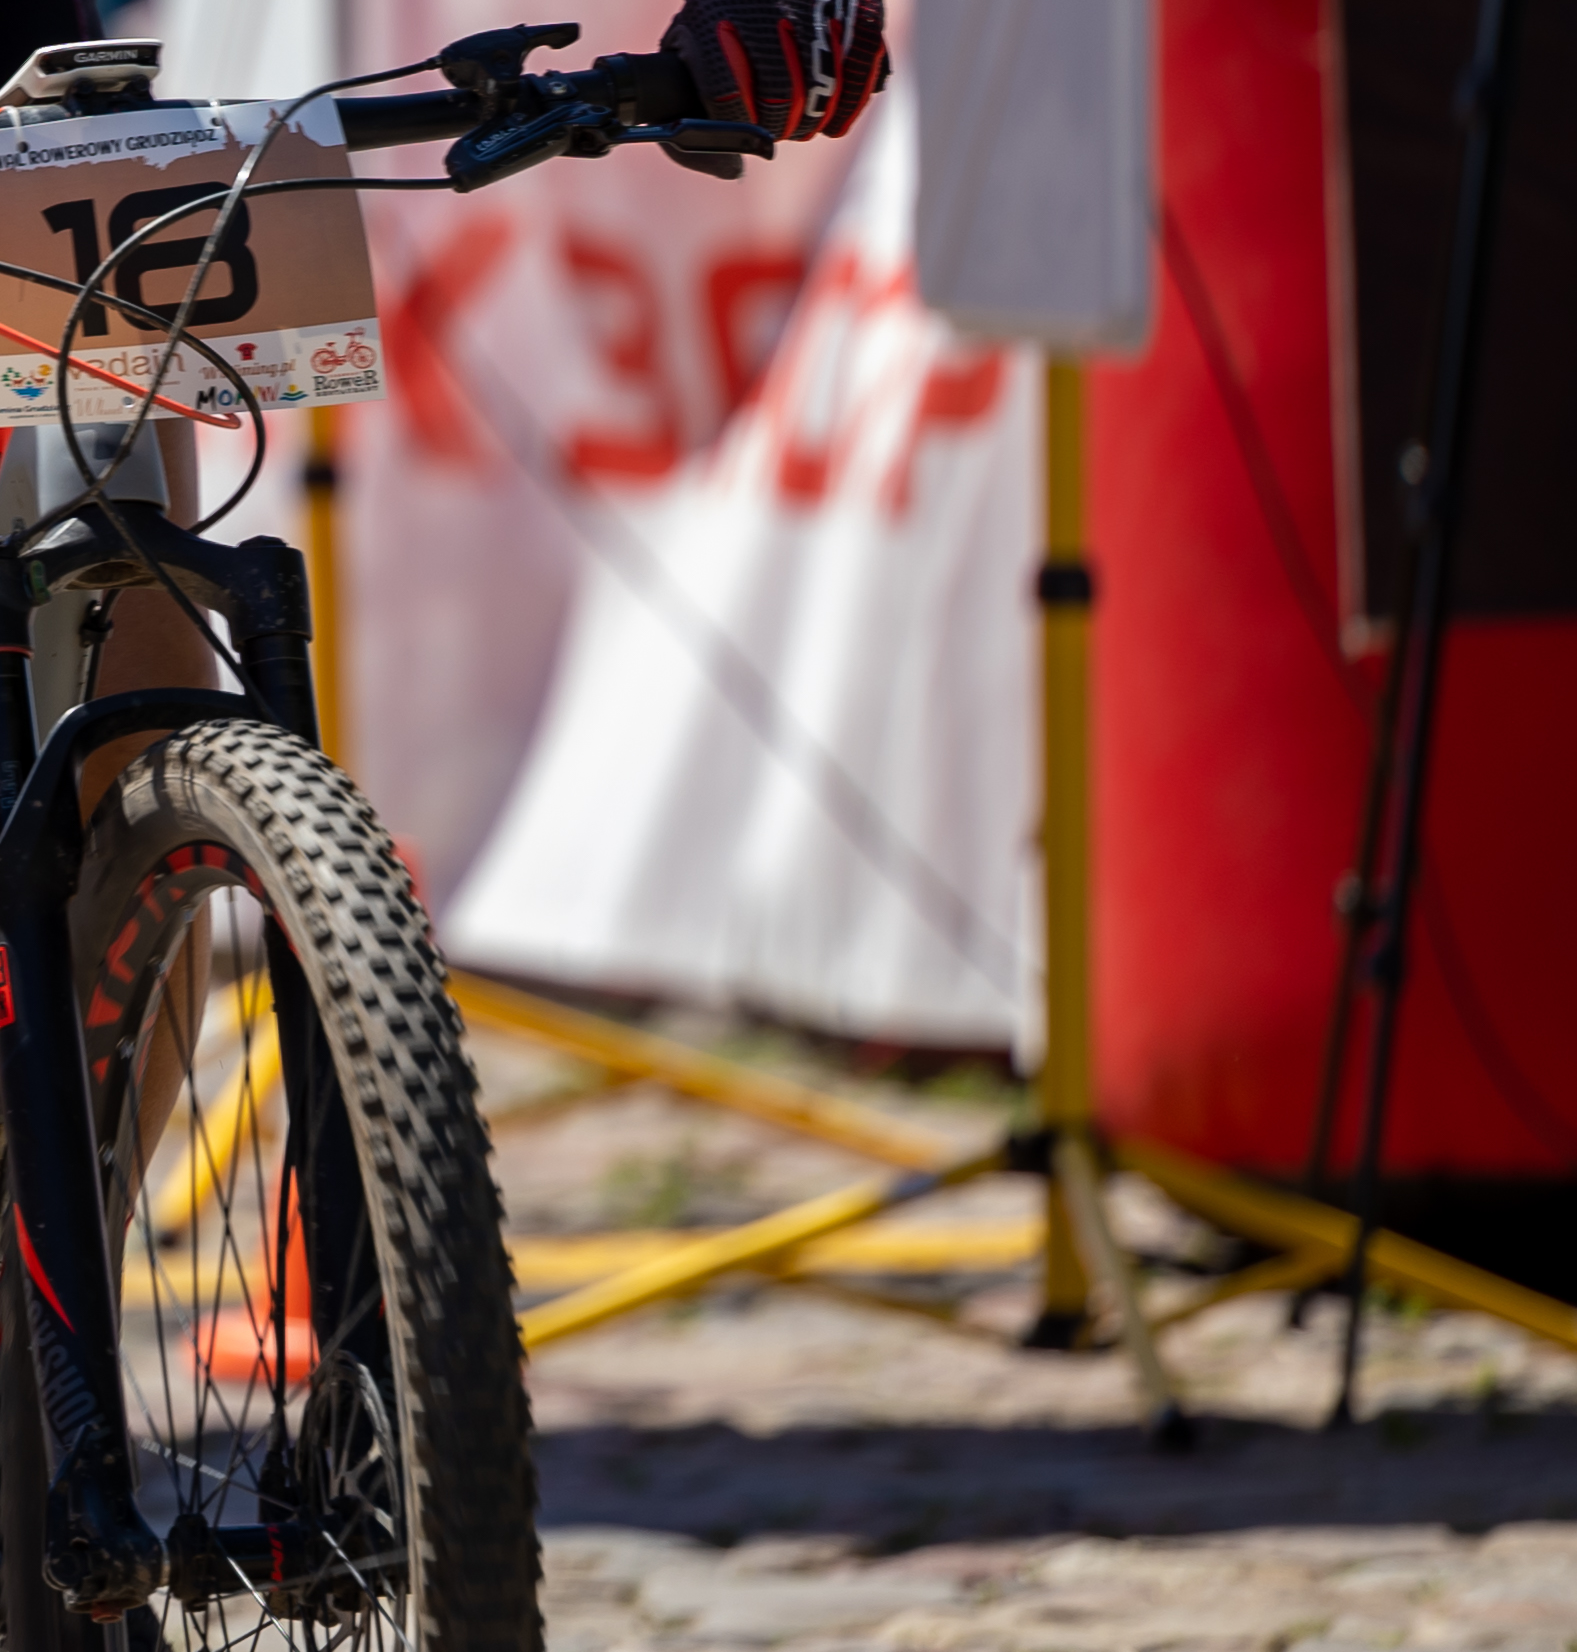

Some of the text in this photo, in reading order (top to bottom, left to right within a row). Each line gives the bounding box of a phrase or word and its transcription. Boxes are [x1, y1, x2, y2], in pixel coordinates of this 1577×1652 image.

[73, 49, 138, 63] GARMIN
[28, 138, 123, 166] ROWEROWY
[125, 128, 219, 151] GRUDZIĄDZ
[40, 180, 258, 338] 18
